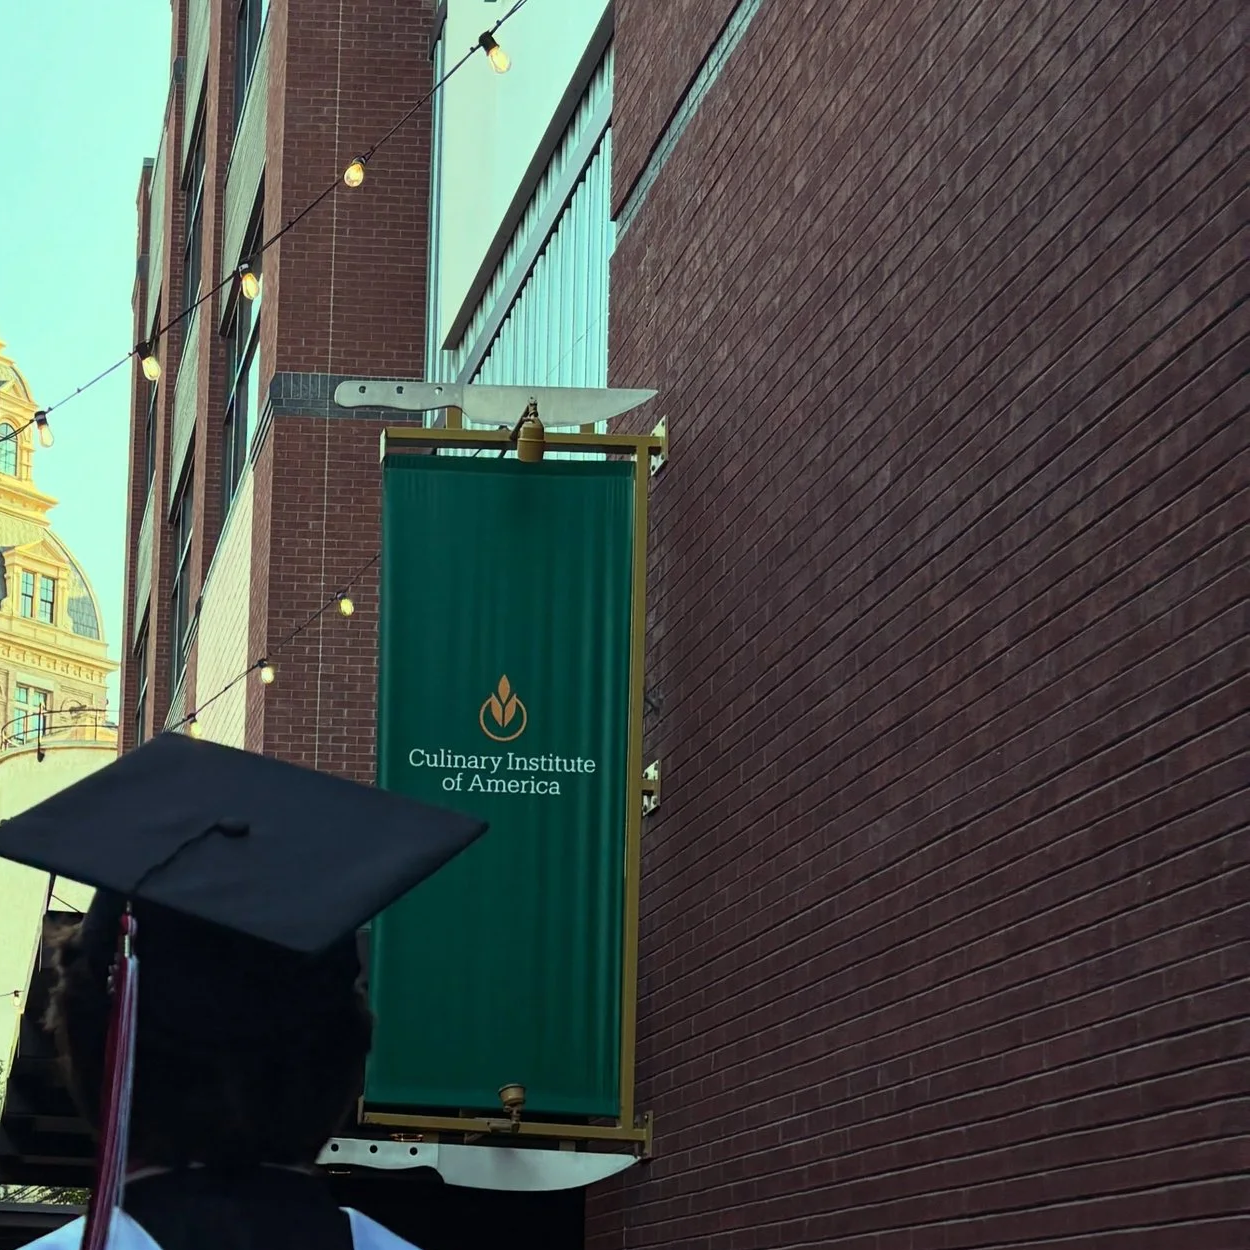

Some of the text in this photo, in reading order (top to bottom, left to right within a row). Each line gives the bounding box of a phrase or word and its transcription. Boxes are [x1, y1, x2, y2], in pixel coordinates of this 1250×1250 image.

[408, 748, 596, 774] Culinary Institute
[441, 772, 561, 796] of America
